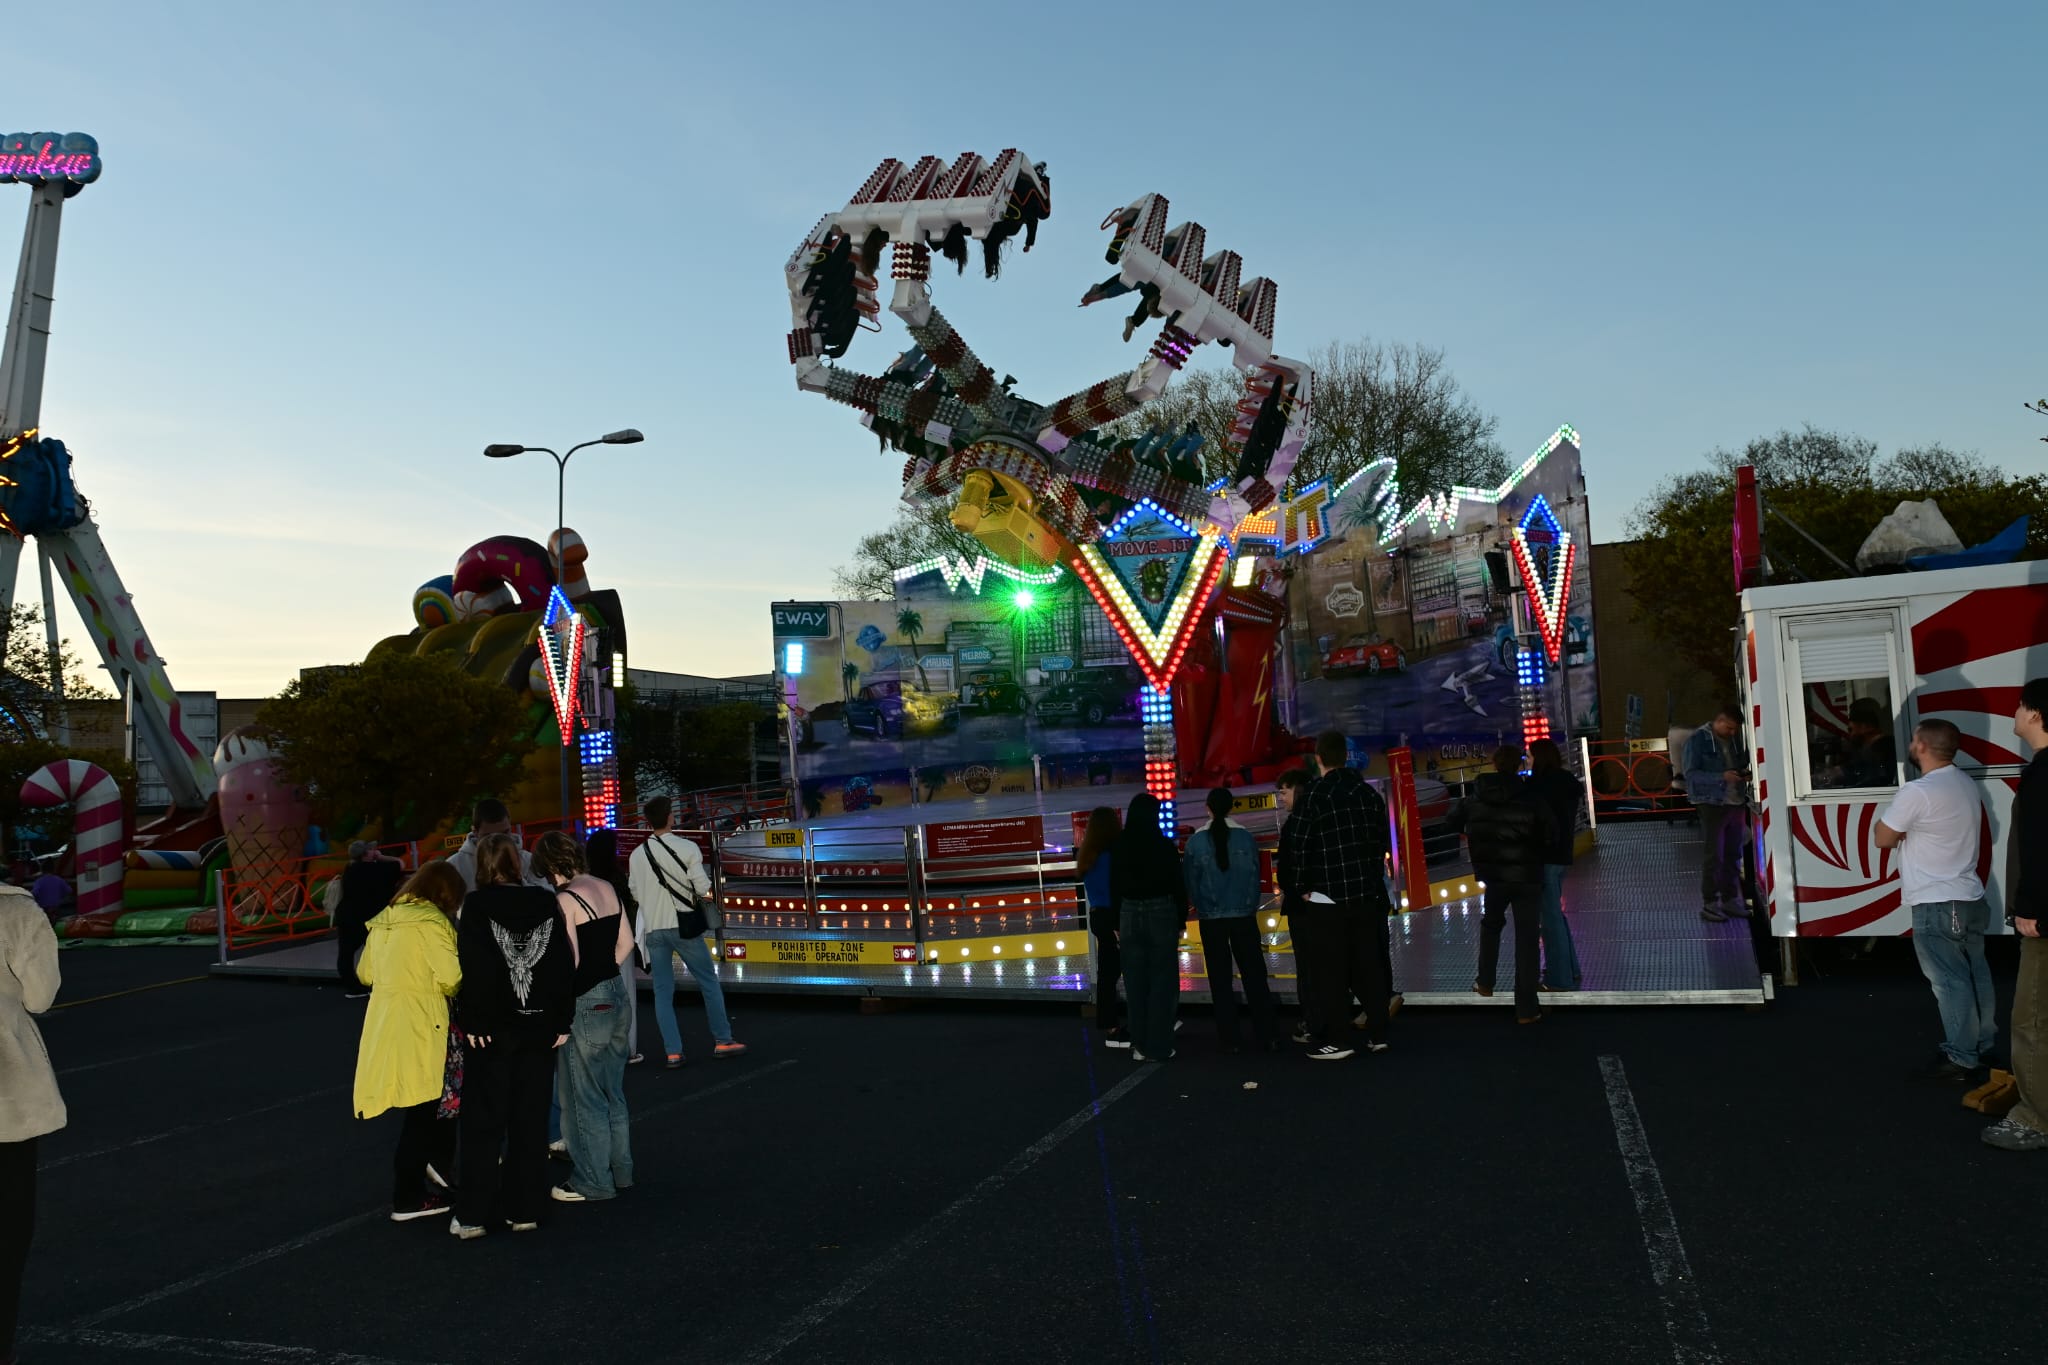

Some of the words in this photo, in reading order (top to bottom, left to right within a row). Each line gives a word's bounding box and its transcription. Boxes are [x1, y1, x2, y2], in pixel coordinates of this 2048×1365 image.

[775, 611, 827, 627] EWAY
[962, 650, 991, 661] MELROSE
[1249, 794, 1268, 809] EXIT
[771, 832, 796, 845] ENTER
[726, 946, 746, 957] STP
[771, 942, 827, 952] PROHIBITED
[840, 942, 865, 953] ZONE
[778, 951, 807, 961] DURING
[815, 952, 859, 962] OPERATION
[894, 948, 916, 959] STP
